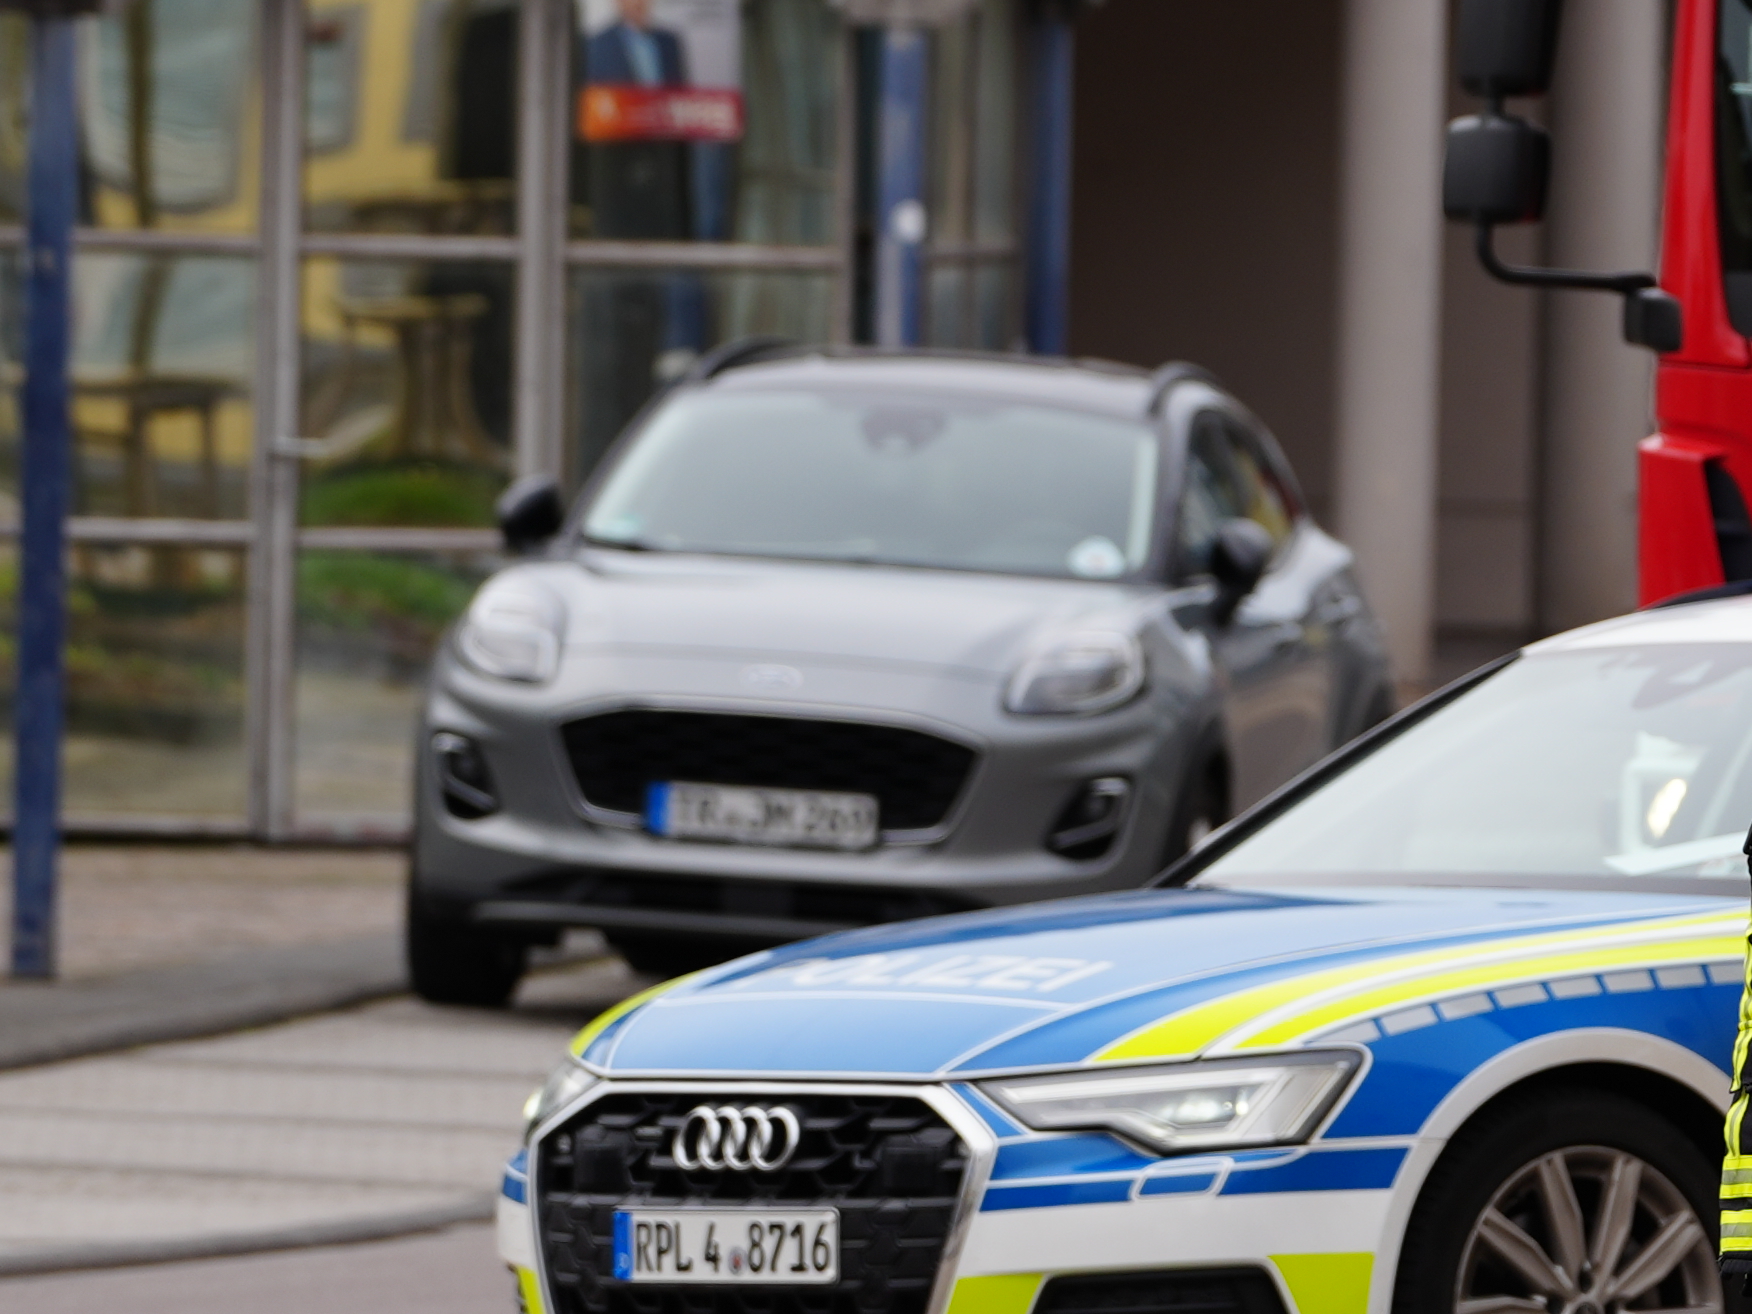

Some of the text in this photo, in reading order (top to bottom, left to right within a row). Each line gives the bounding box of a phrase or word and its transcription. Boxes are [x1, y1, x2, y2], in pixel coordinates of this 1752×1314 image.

[635, 1220, 831, 1273] RPL 4 8716
